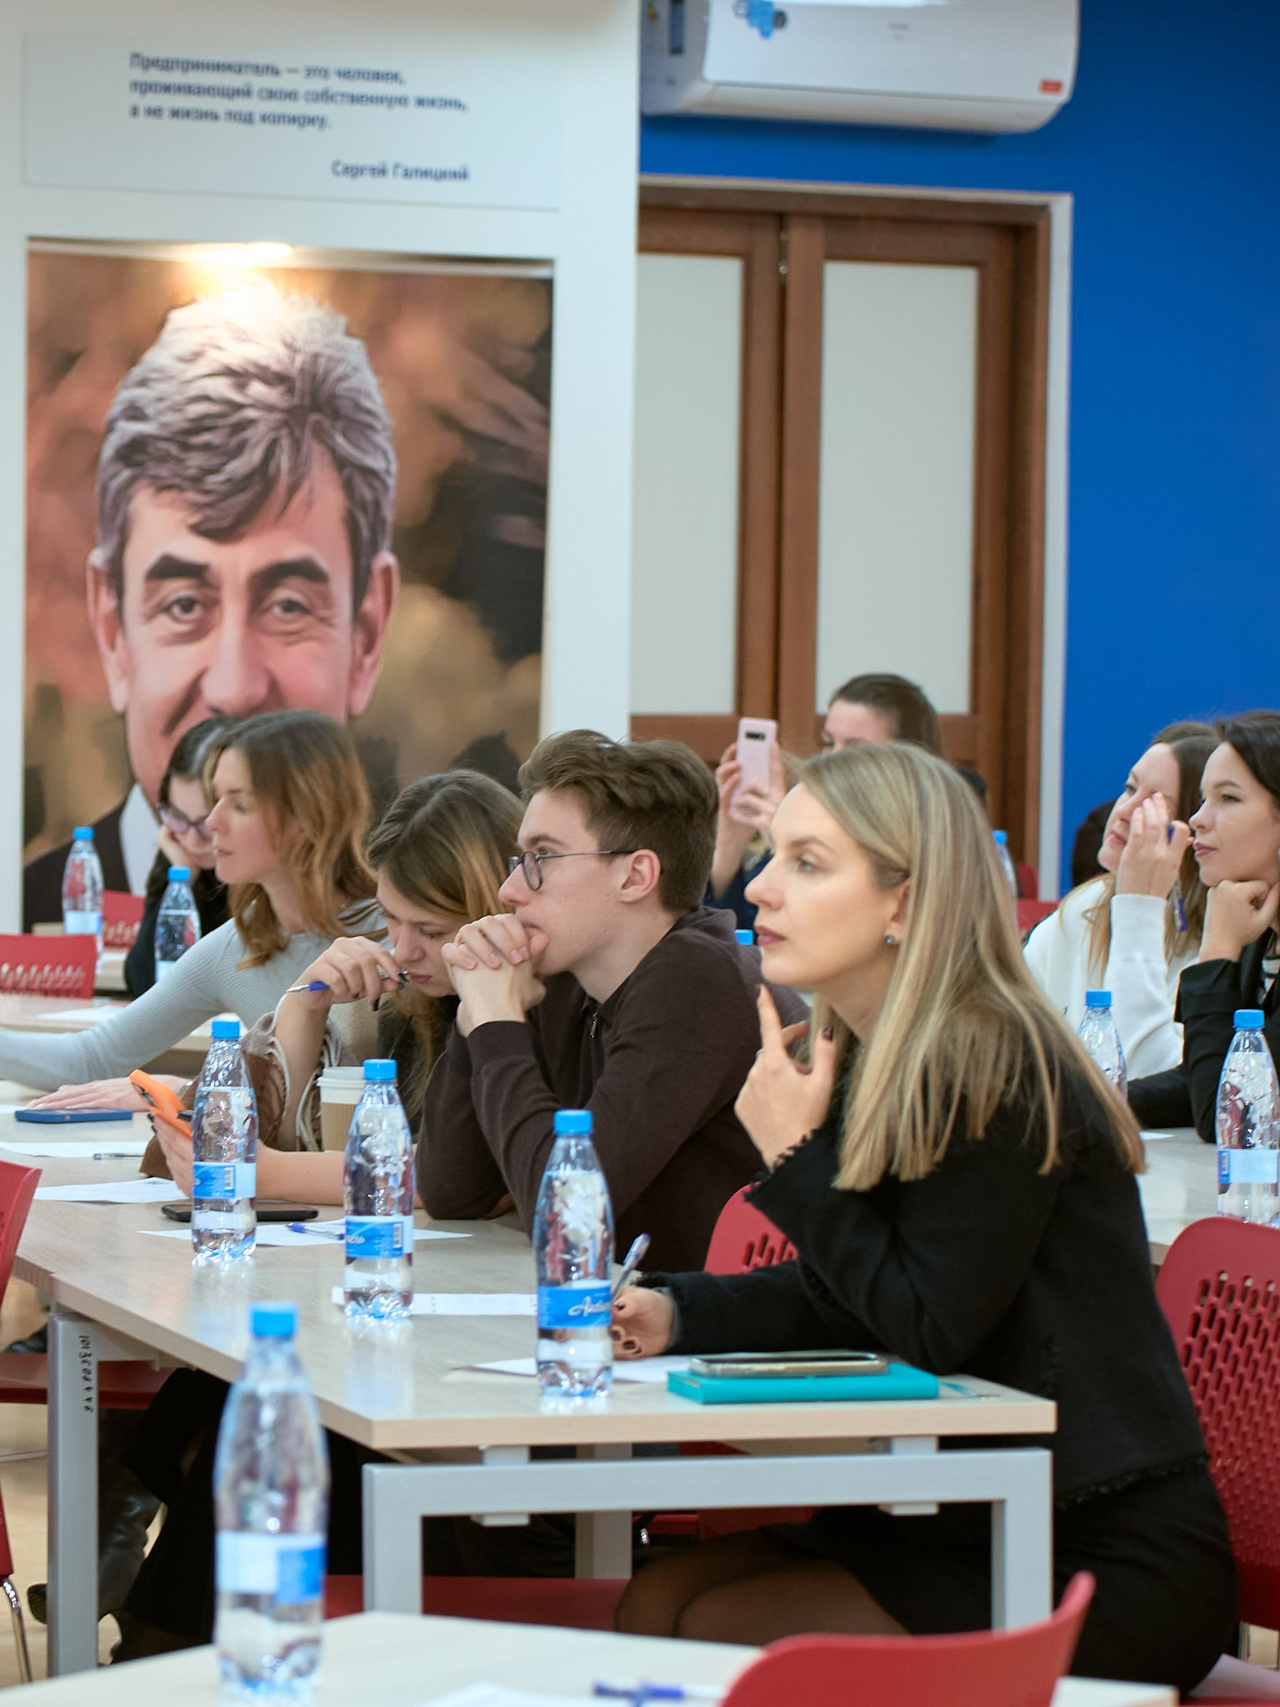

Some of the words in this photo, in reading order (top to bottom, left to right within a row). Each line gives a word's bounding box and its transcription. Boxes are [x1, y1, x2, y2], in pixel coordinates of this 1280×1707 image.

[130, 52, 281, 77] Предприниматель
[305, 66, 330, 79] это
[130, 80, 253, 100] проживающий
[257, 88, 299, 102] свою
[303, 87, 409, 108] собственную
[130, 105, 140, 118] а
[144, 106, 164, 119] не
[168, 107, 220, 122] жизнь
[224, 110, 255, 125] под
[331, 160, 388, 179] Сергей
[392, 163, 469, 181] Галицкий
